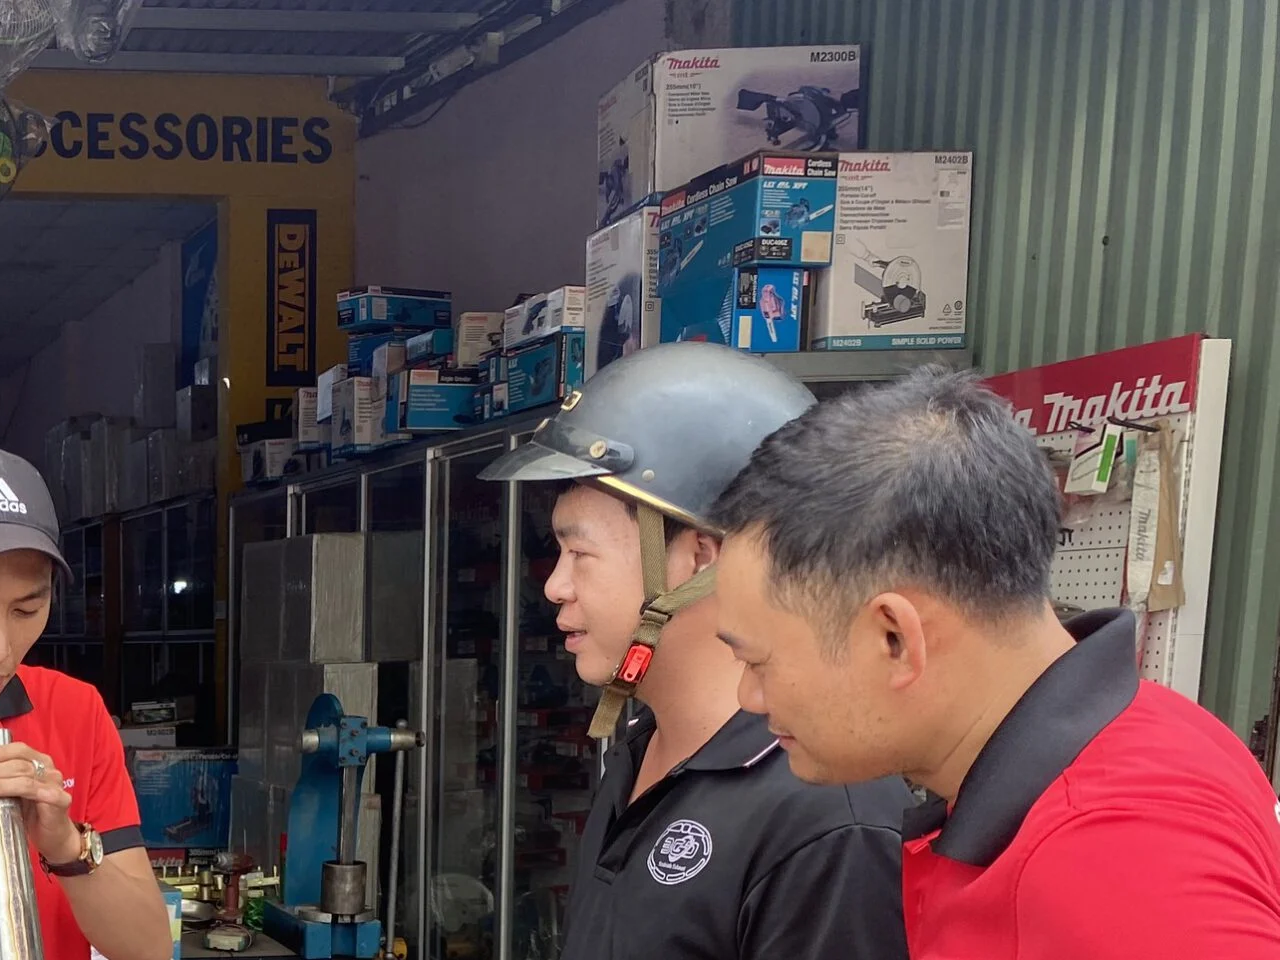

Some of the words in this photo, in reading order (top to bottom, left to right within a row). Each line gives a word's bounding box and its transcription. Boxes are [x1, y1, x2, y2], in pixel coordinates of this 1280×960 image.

[809, 51, 857, 63] M2300B
[934, 155, 969, 165] M2402B
[278, 224, 306, 371] DEWALT
[891, 337, 915, 346] SIMPLE
[916, 337, 937, 345] SOLID
[938, 336, 962, 345] POWER
[151, 856, 184, 868] akita
